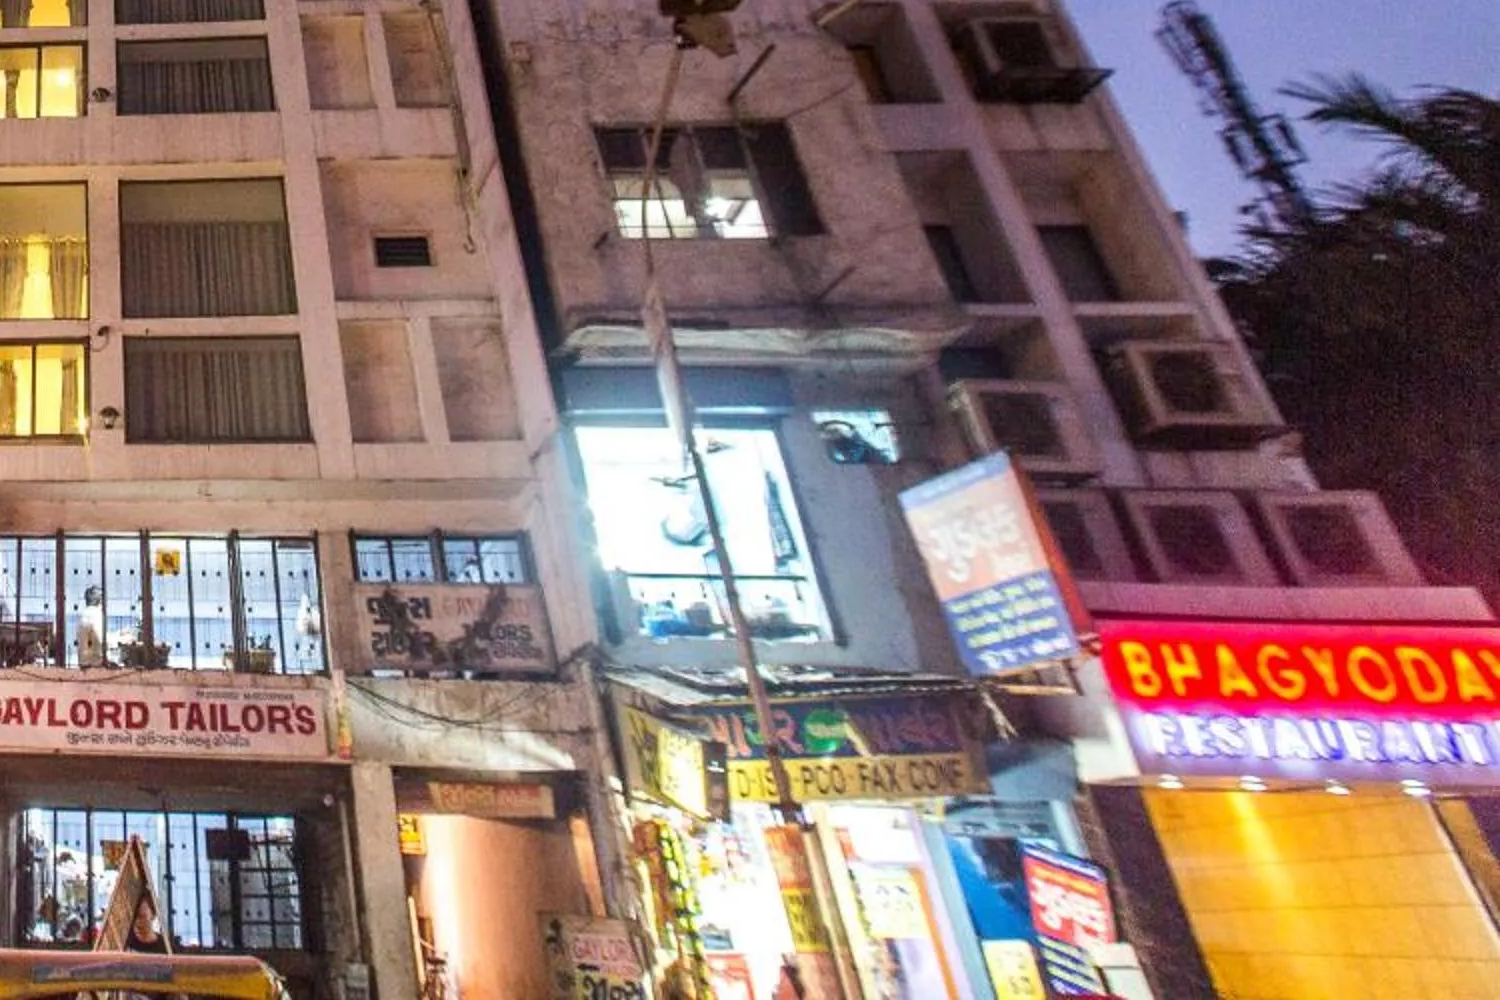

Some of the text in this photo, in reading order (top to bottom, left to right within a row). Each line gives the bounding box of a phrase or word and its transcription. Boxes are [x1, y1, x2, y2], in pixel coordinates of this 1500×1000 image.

[161, 699, 317, 736] TAILOR'S
[802, 763, 846, 795] PCO
[859, 761, 902, 792] FAX
